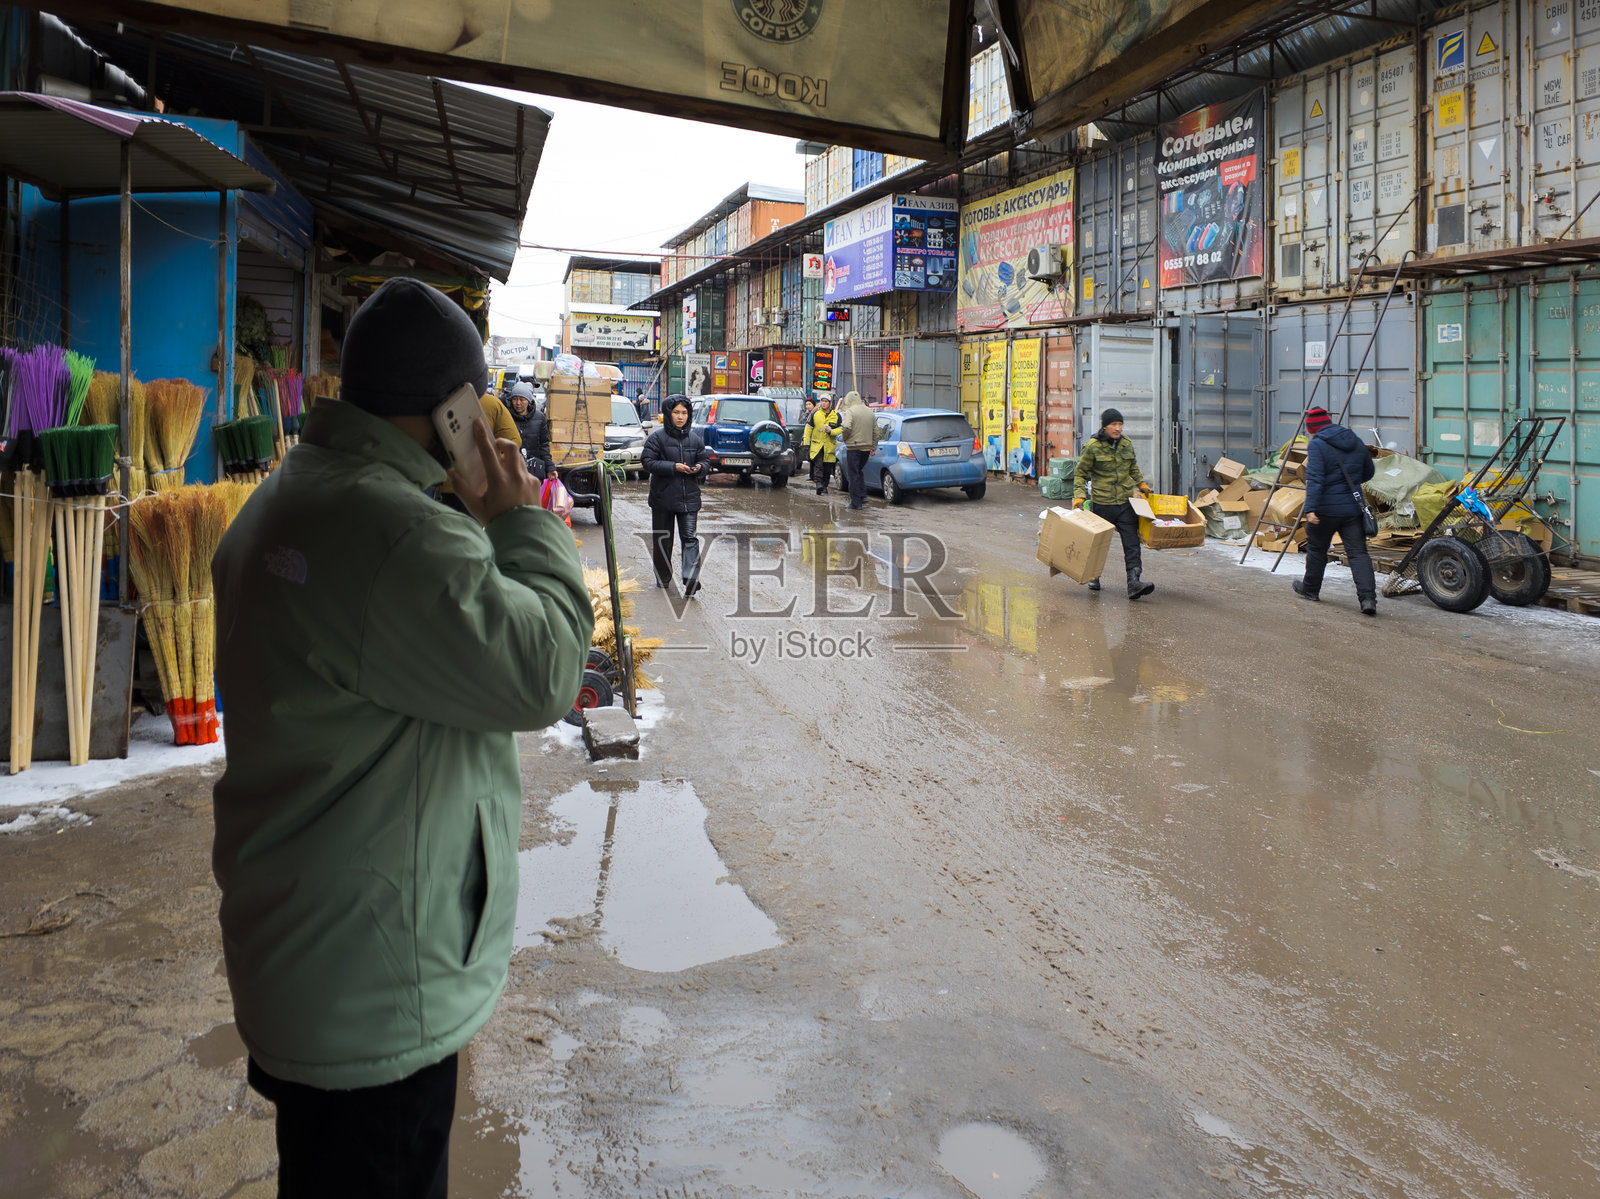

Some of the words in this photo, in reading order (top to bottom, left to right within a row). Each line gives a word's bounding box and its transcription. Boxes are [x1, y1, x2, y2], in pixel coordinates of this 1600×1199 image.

[1546, 3, 1567, 19] CBHU
[741, 7, 808, 39] COFFEE
[1357, 75, 1373, 88] CBHU
[1440, 95, 1461, 106] CAUTION
[1162, 116, 1243, 157] Сотовые
[1244, 117, 1253, 131] и
[1158, 136, 1256, 174] Компьютерные
[1160, 167, 1217, 190] аксессуары
[908, 199, 927, 208] FAN
[929, 201, 955, 210] АЗИЯ
[963, 203, 1000, 226] СОТОВЫЕ
[1003, 179, 1071, 215] АКСЕССУАРЫ
[835, 219, 852, 242] FAN
[860, 204, 887, 236] АЗИЯ
[1164, 258, 1183, 270] 0555
[1184, 255, 1195, 267] 77
[1197, 253, 1209, 265] 88
[1211, 251, 1222, 263] 02
[834, 312, 849, 320] FAN
[500, 345, 529, 356] Люстры
